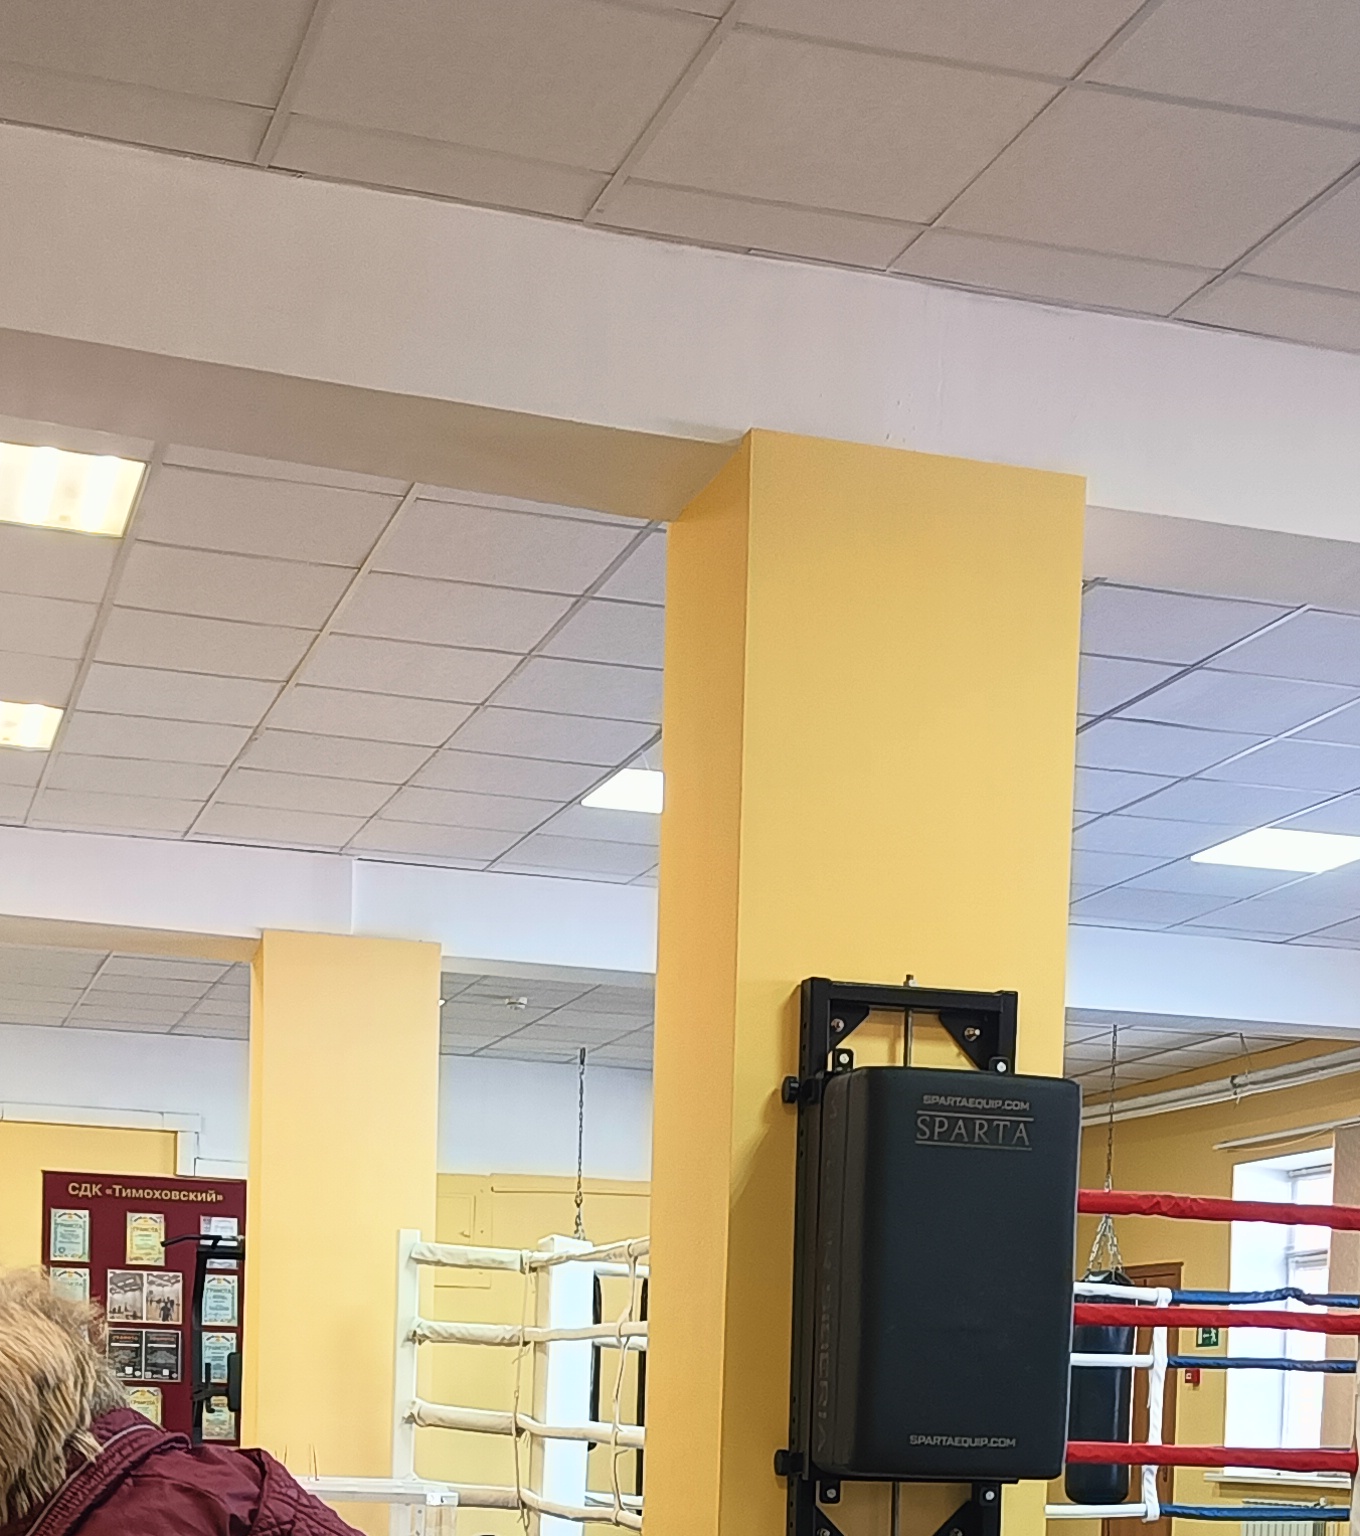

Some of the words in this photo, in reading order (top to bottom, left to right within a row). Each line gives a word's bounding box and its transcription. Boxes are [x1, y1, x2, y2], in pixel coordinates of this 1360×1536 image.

[923, 1095, 1030, 1111] SPARTAEQUIP.COM
[916, 1115, 1030, 1147] SPARTA
[67, 1182, 103, 1198] СДК
[105, 1184, 224, 1203] «Тимоховский»
[909, 1435, 1017, 1448] SPARTAEQUIP.COM
